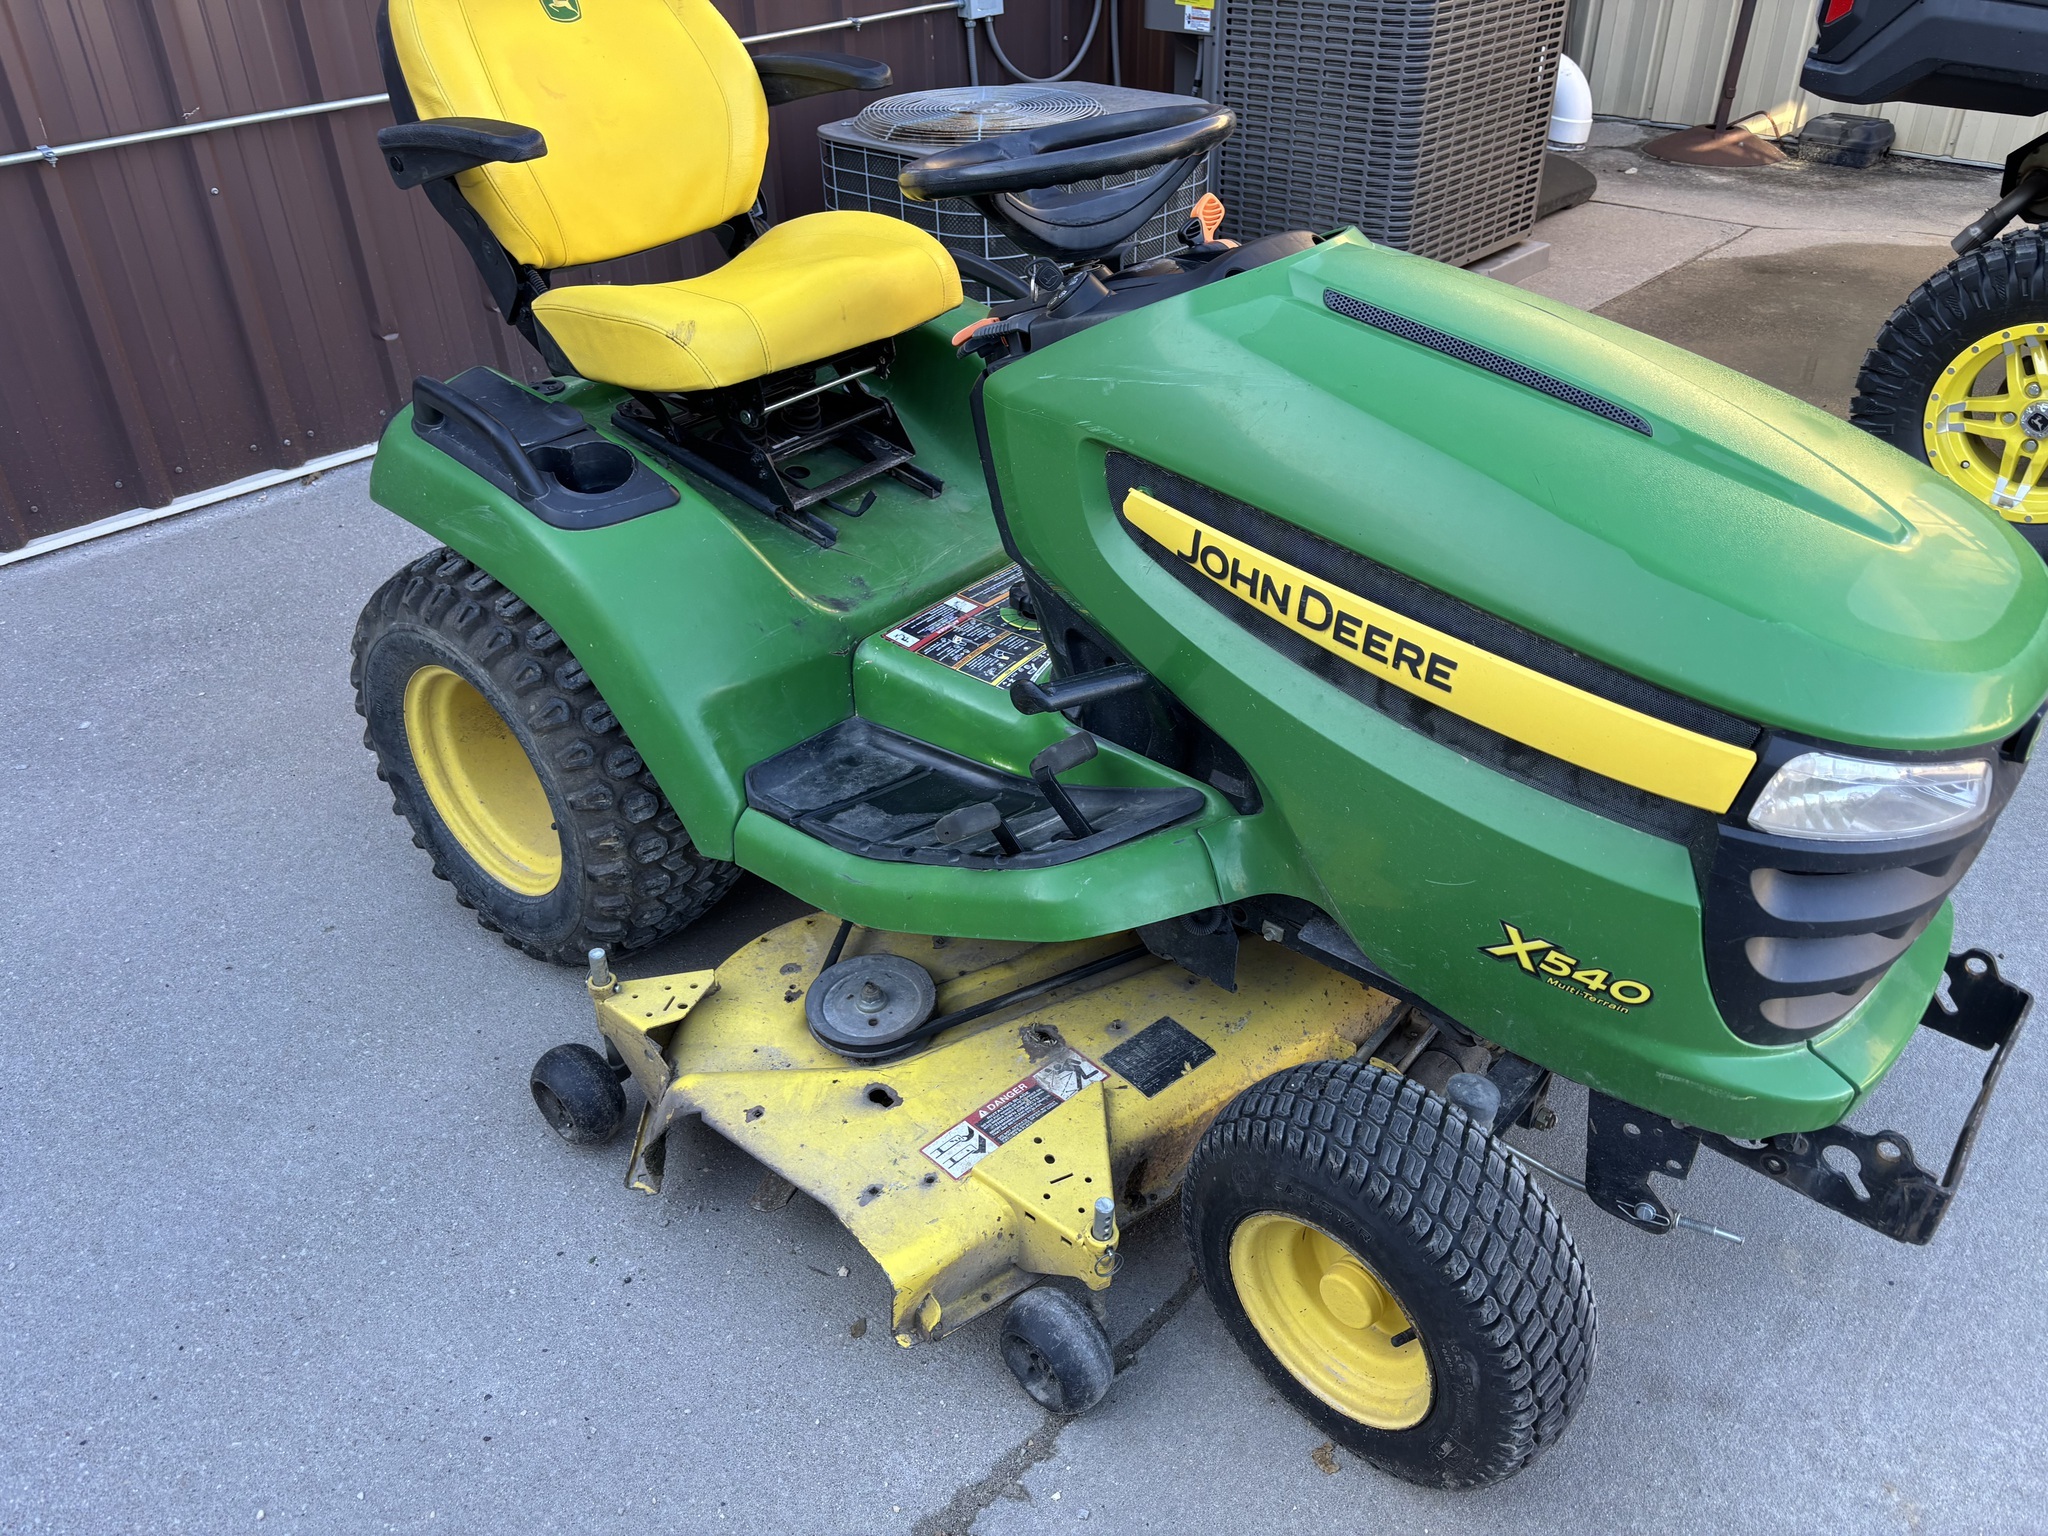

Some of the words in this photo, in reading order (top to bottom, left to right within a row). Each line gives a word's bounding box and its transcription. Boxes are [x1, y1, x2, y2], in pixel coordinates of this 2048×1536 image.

[1177, 529, 1291, 616] JOHN
[1296, 584, 1458, 693] DEERE
[1479, 920, 1654, 1006] X540
[1546, 976, 1630, 1015] Multi-Terrain
[986, 1083, 1028, 1111] DANGER
